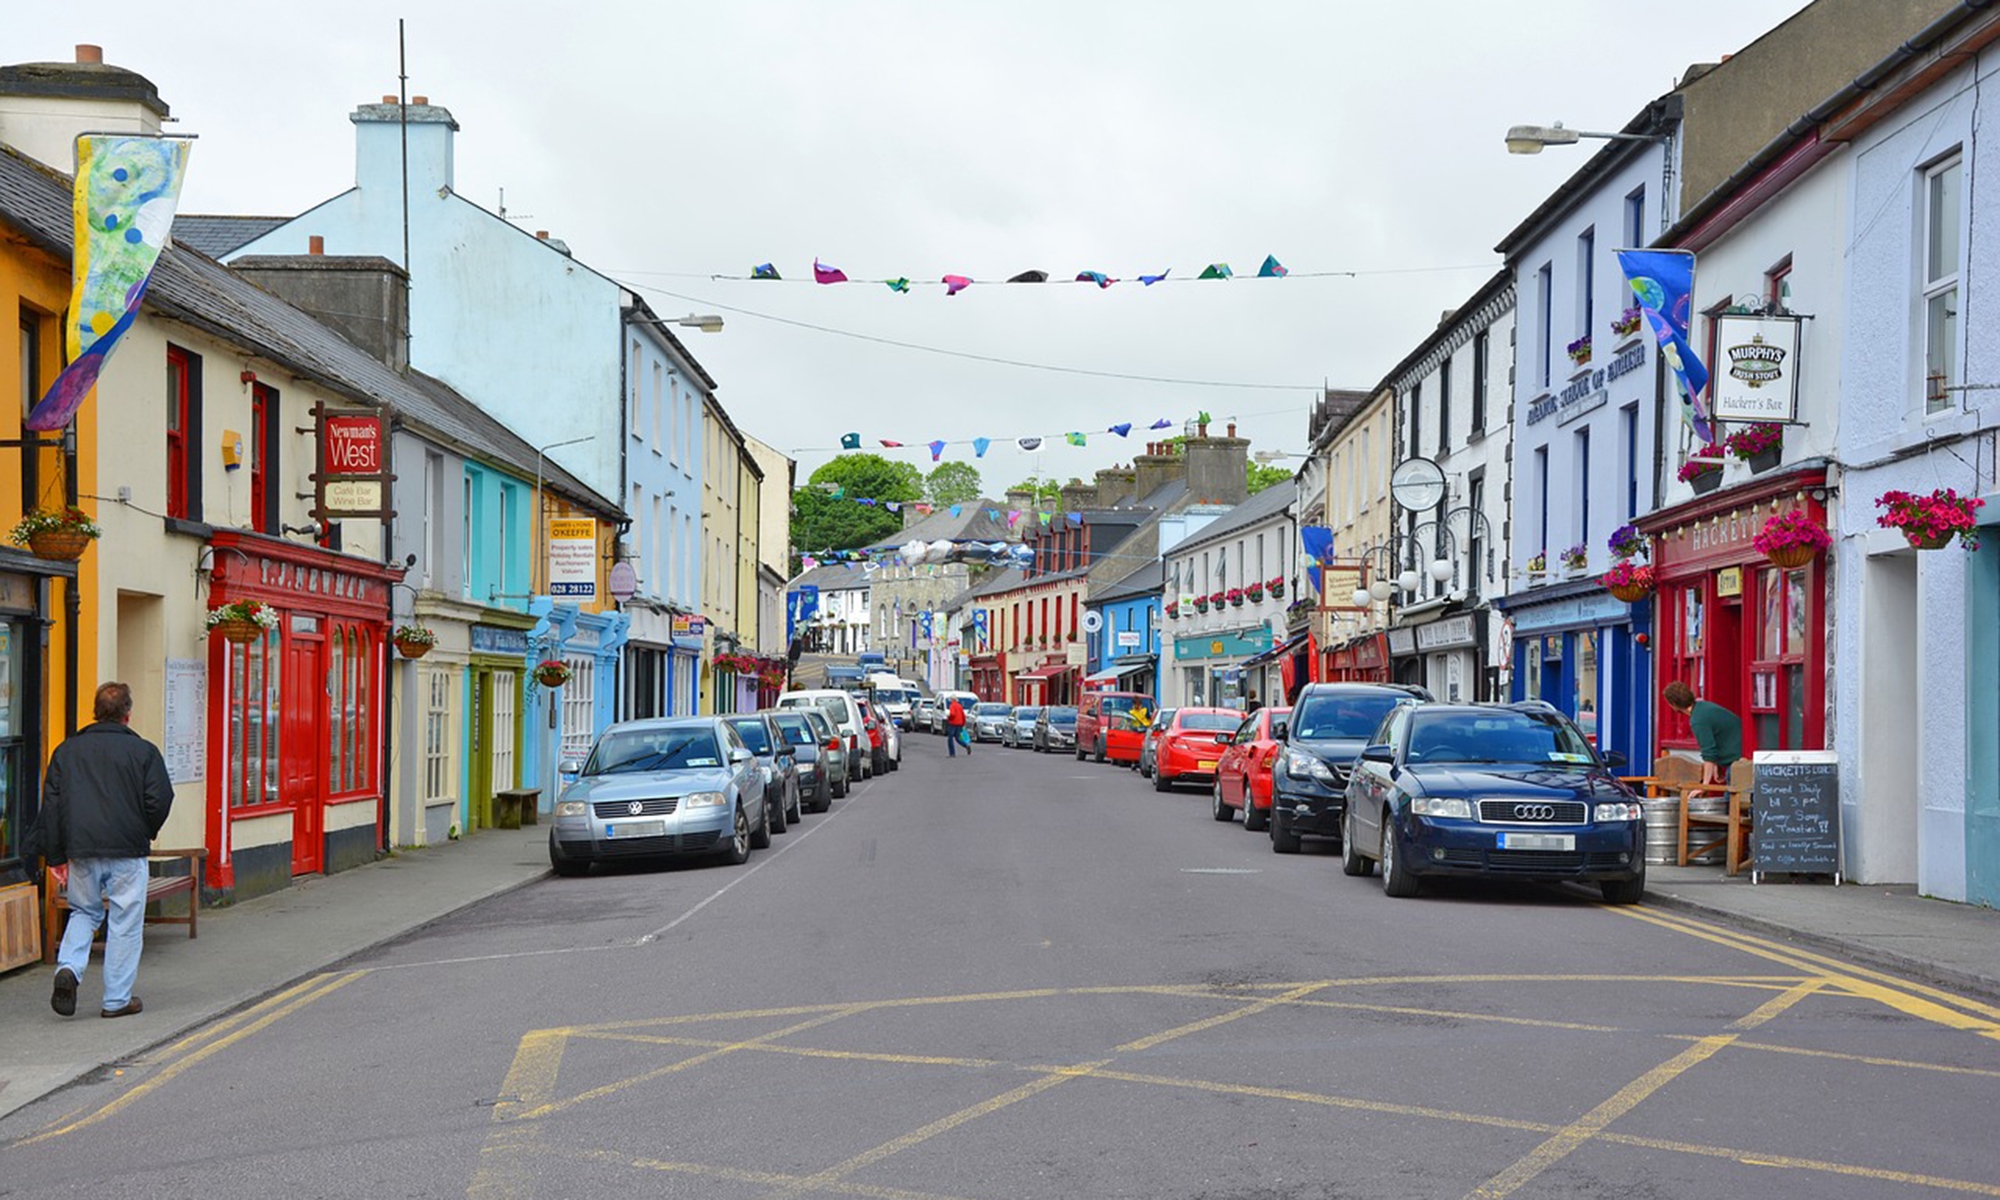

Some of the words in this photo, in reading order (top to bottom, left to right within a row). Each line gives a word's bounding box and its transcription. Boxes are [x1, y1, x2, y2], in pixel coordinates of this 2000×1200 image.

[1733, 369, 1753, 379] IRISH
[1755, 370, 1779, 380] STOUT
[1723, 396, 1764, 410] Hackett's
[1766, 398, 1782, 410] Bar
[330, 423, 377, 438] Newman's
[330, 438, 376, 467] West
[356, 486, 372, 496] Bar
[333, 497, 355, 506] Wine
[357, 497, 373, 506] Bar
[1693, 513, 1759, 550] HACKETT
[551, 544, 576, 552] Property
[551, 585, 566, 593] 028
[568, 585, 593, 593] 28122
[1761, 783, 1792, 794] Served
[1799, 783, 1821, 799] Daily
